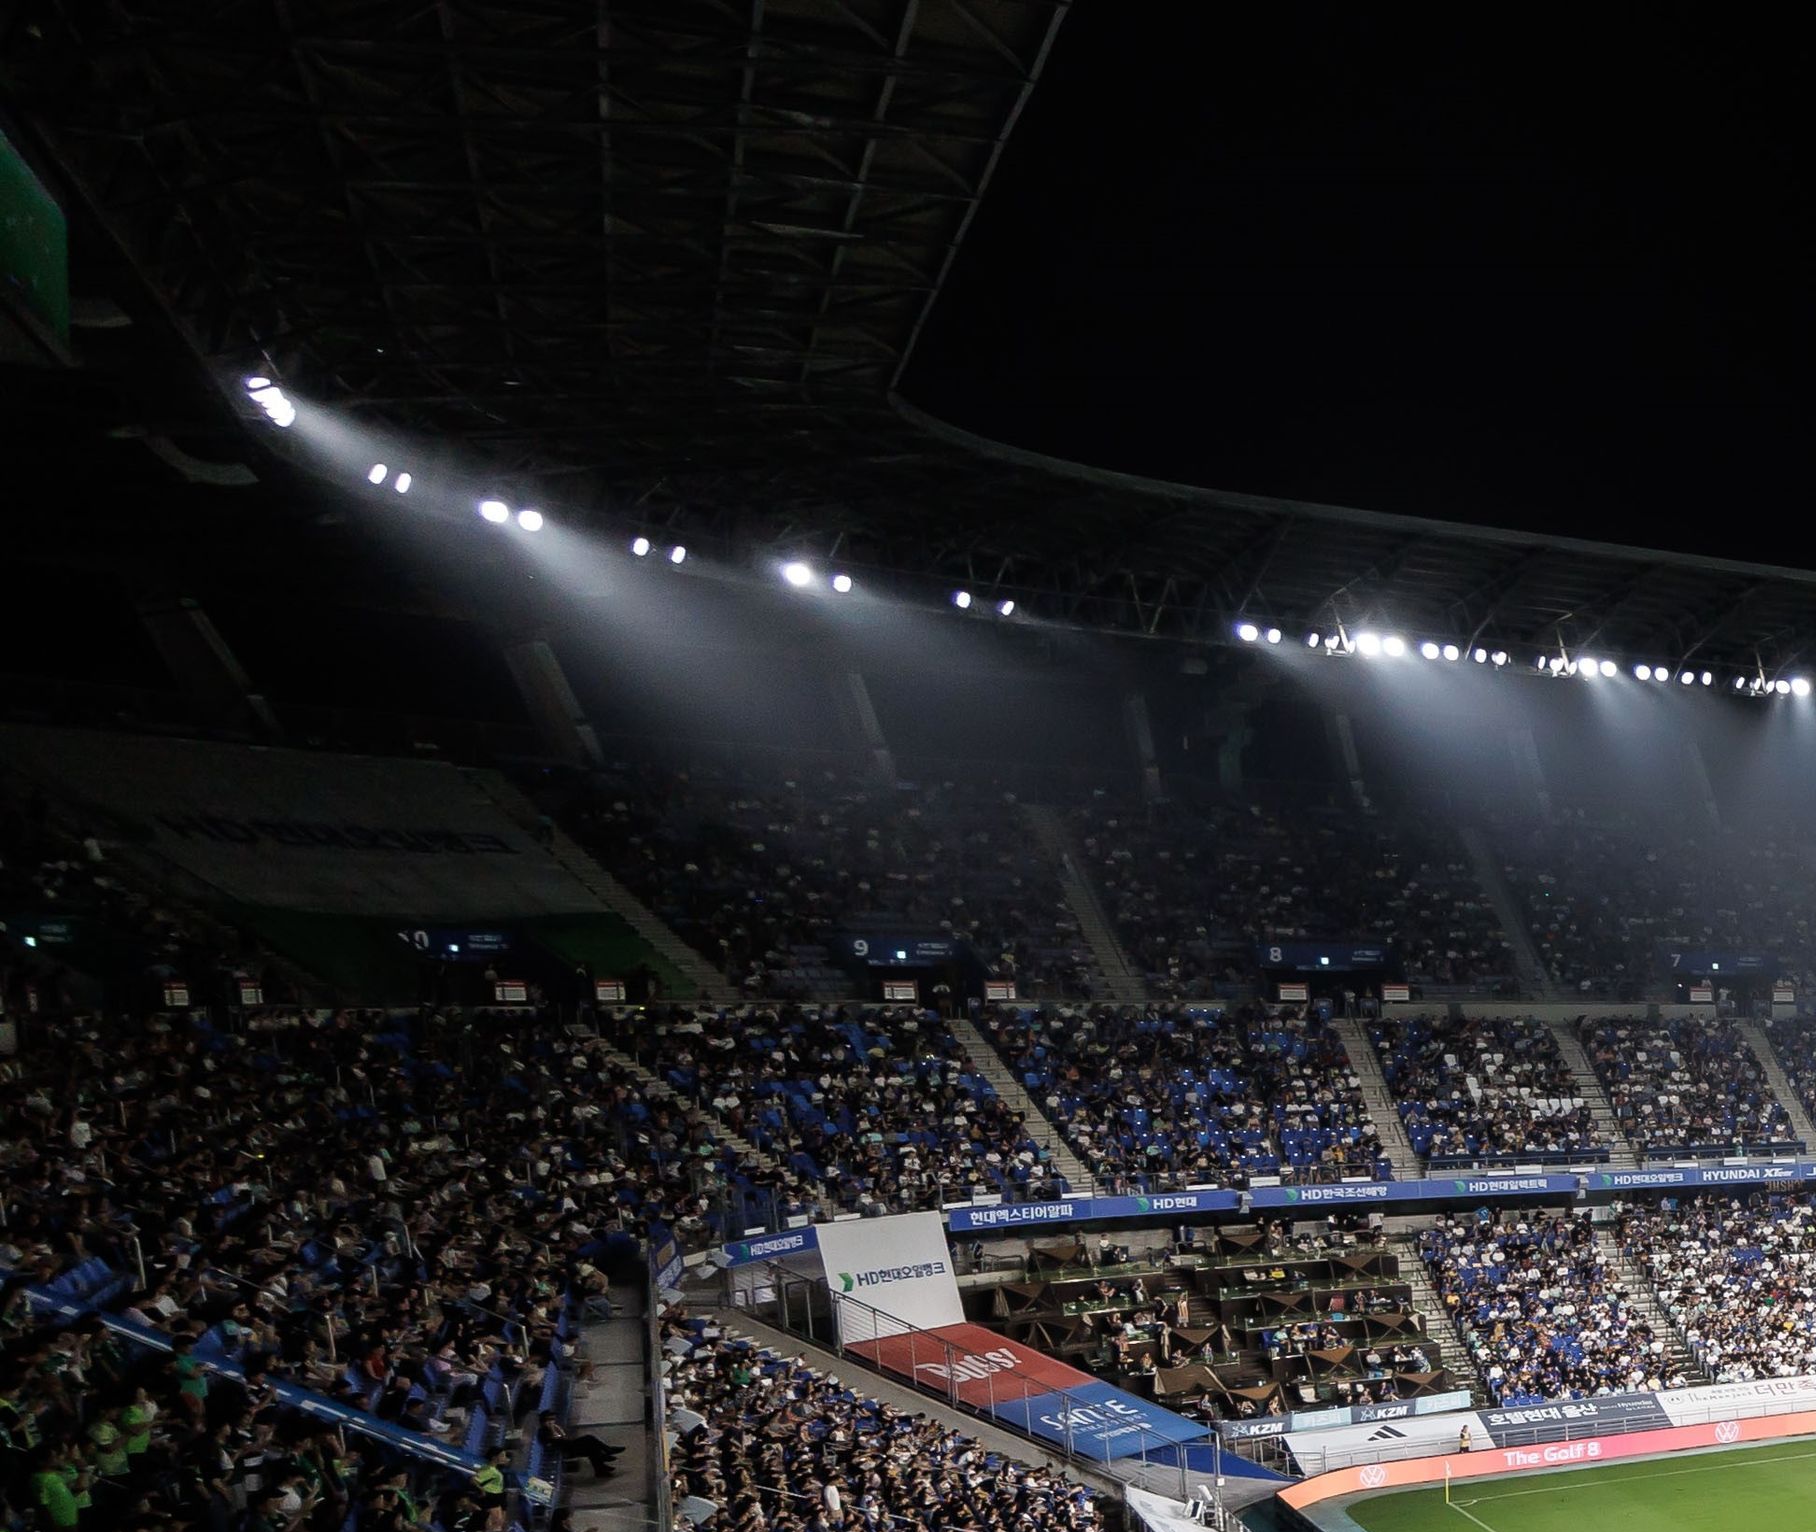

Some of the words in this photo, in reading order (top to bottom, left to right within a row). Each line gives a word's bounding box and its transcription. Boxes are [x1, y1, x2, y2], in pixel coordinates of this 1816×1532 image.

[853, 939, 869, 957] 9
[1269, 946, 1282, 963] 8
[1670, 953, 1681, 968] 7
[1702, 1169, 1760, 1181] HYUNDAI
[1301, 1186, 1388, 1201] HD한국조선해양
[970, 1204, 1074, 1226] 현대엑스티어알파
[856, 1262, 946, 1287] HD현대오일뱅크
[1377, 1406, 1408, 1419] KZM
[1487, 1407, 1562, 1427] 호텔현대
[1561, 1402, 1599, 1419] 울산
[1250, 1423, 1285, 1435] KZM
[1504, 1450, 1538, 1466] The
[1544, 1443, 1586, 1463] Golf
[1587, 1441, 1601, 1457] 8
